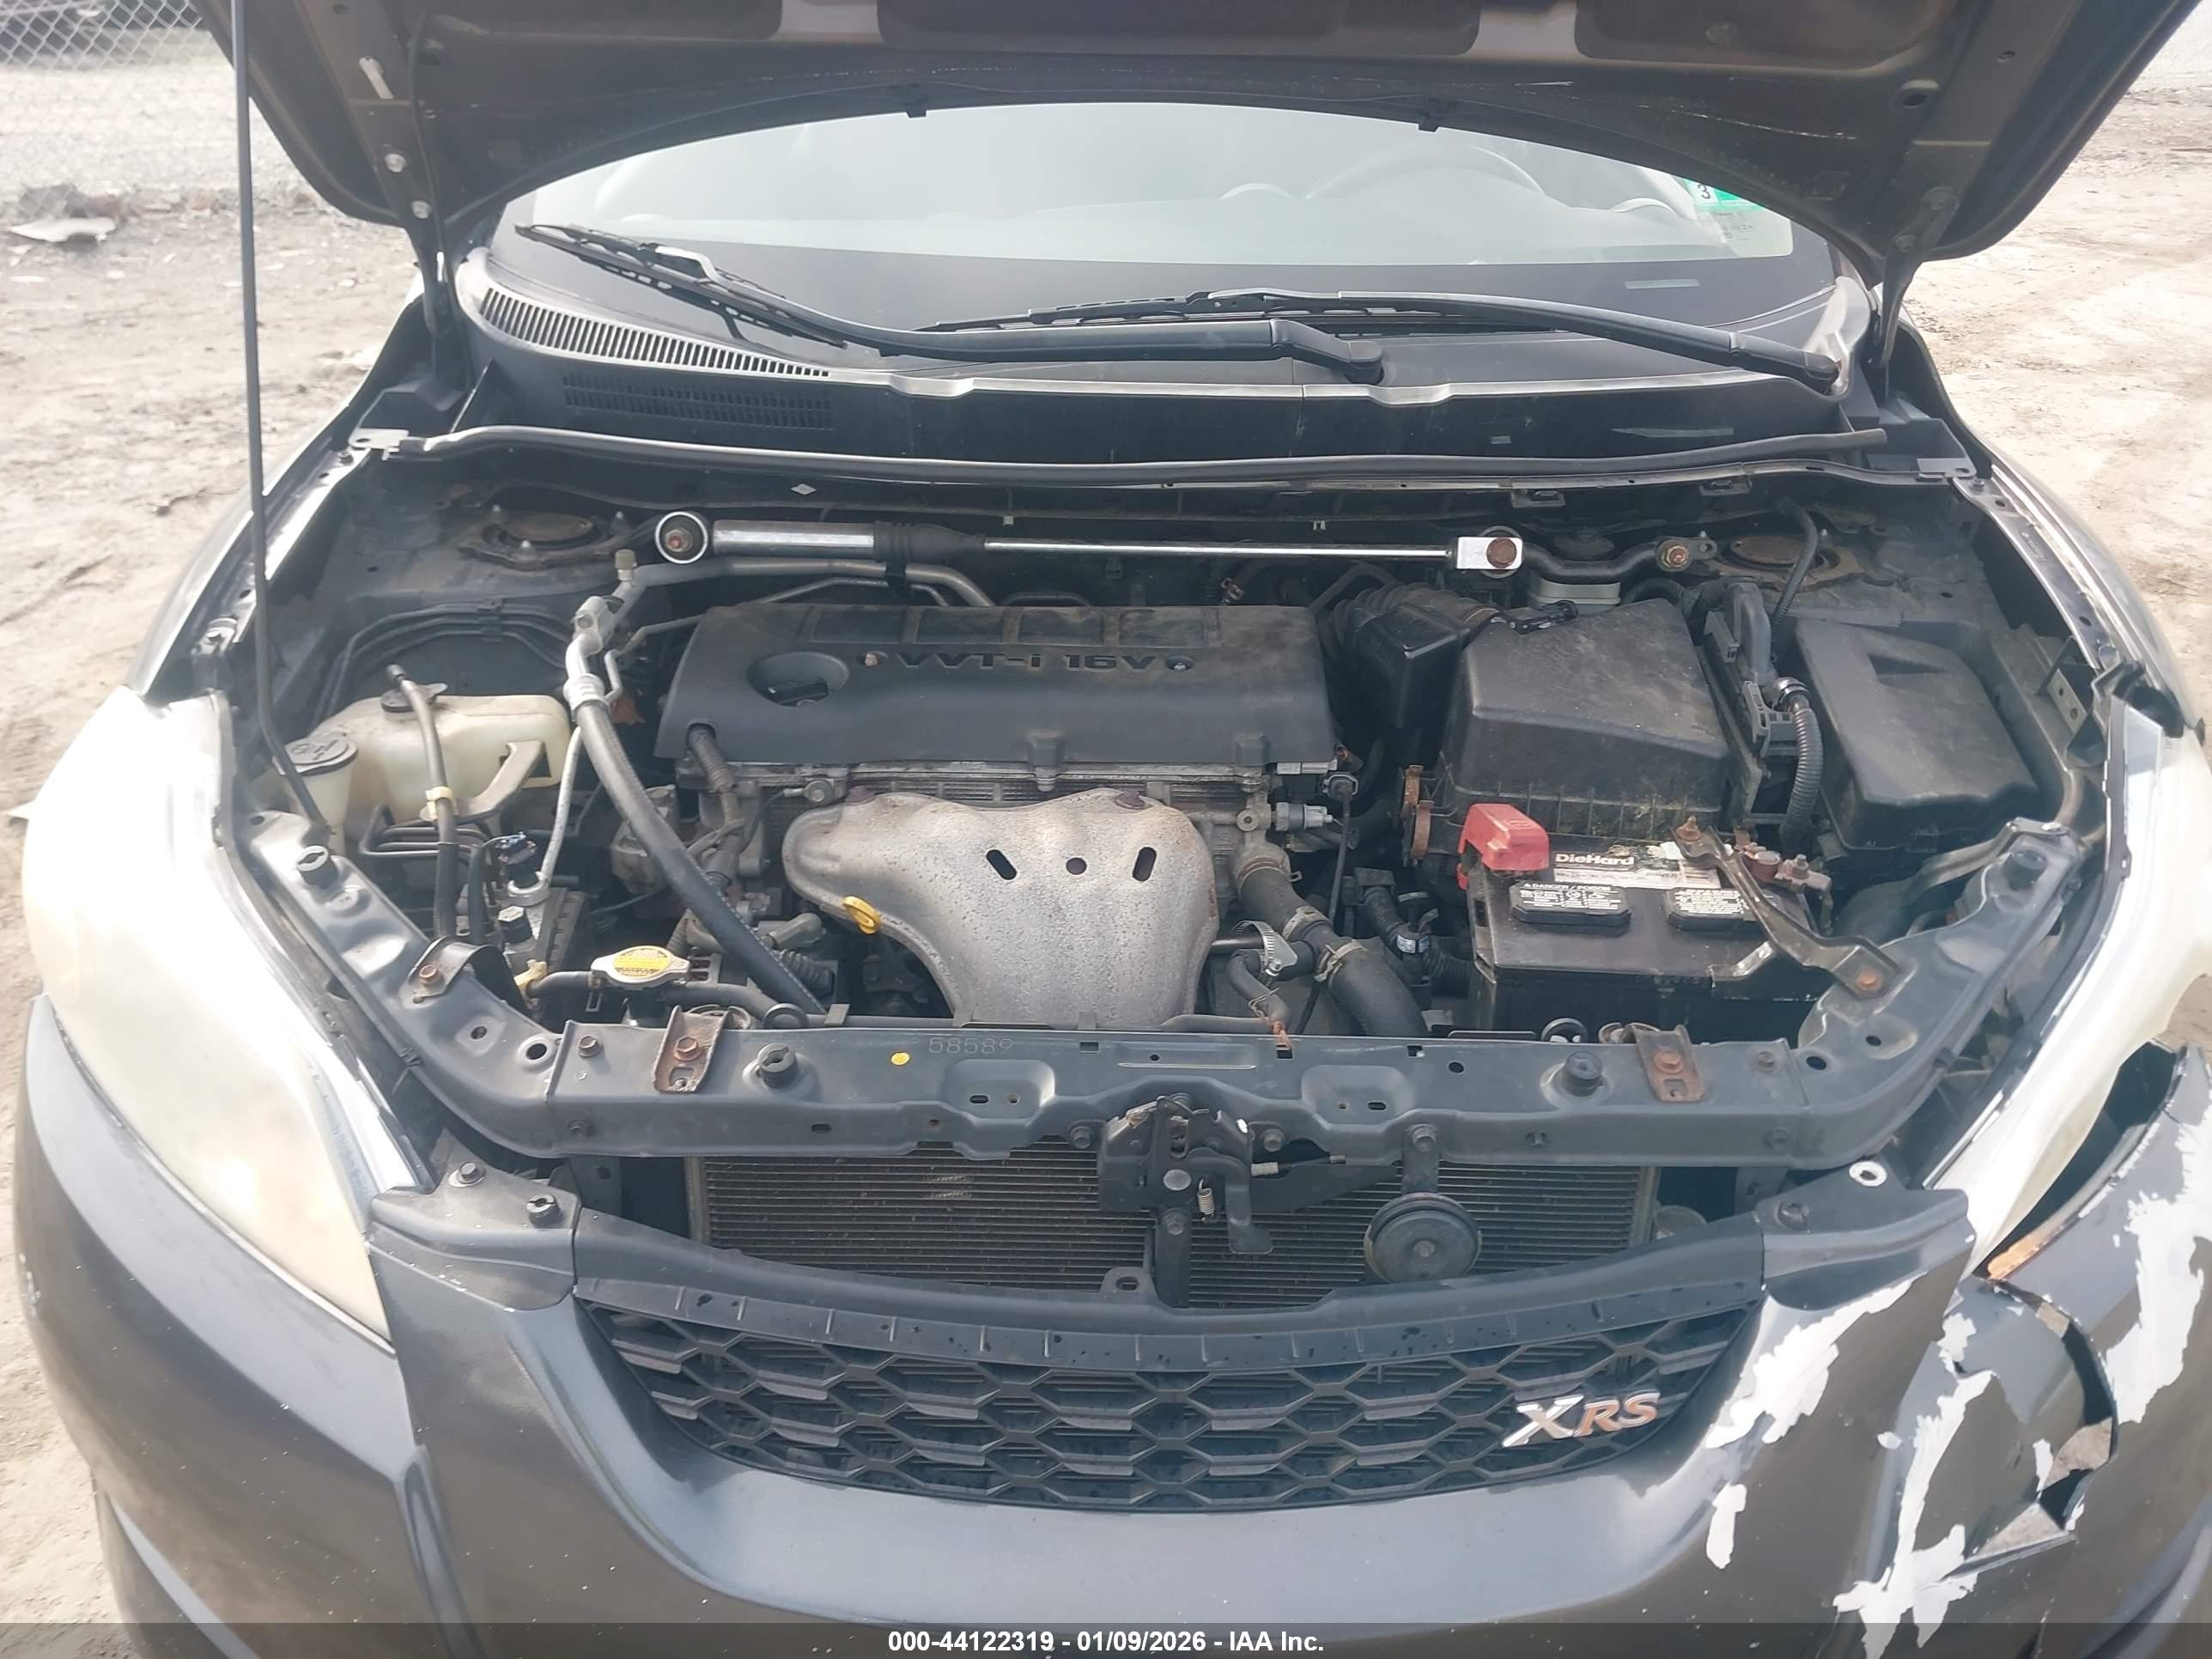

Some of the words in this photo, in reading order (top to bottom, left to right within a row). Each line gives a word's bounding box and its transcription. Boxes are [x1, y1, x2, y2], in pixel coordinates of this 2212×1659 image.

[1064, 653, 1158, 672] 16V
[1555, 854, 1635, 866] DieHard
[928, 1036, 1014, 1054] 58589
[1502, 1389, 1662, 1448] XRS
